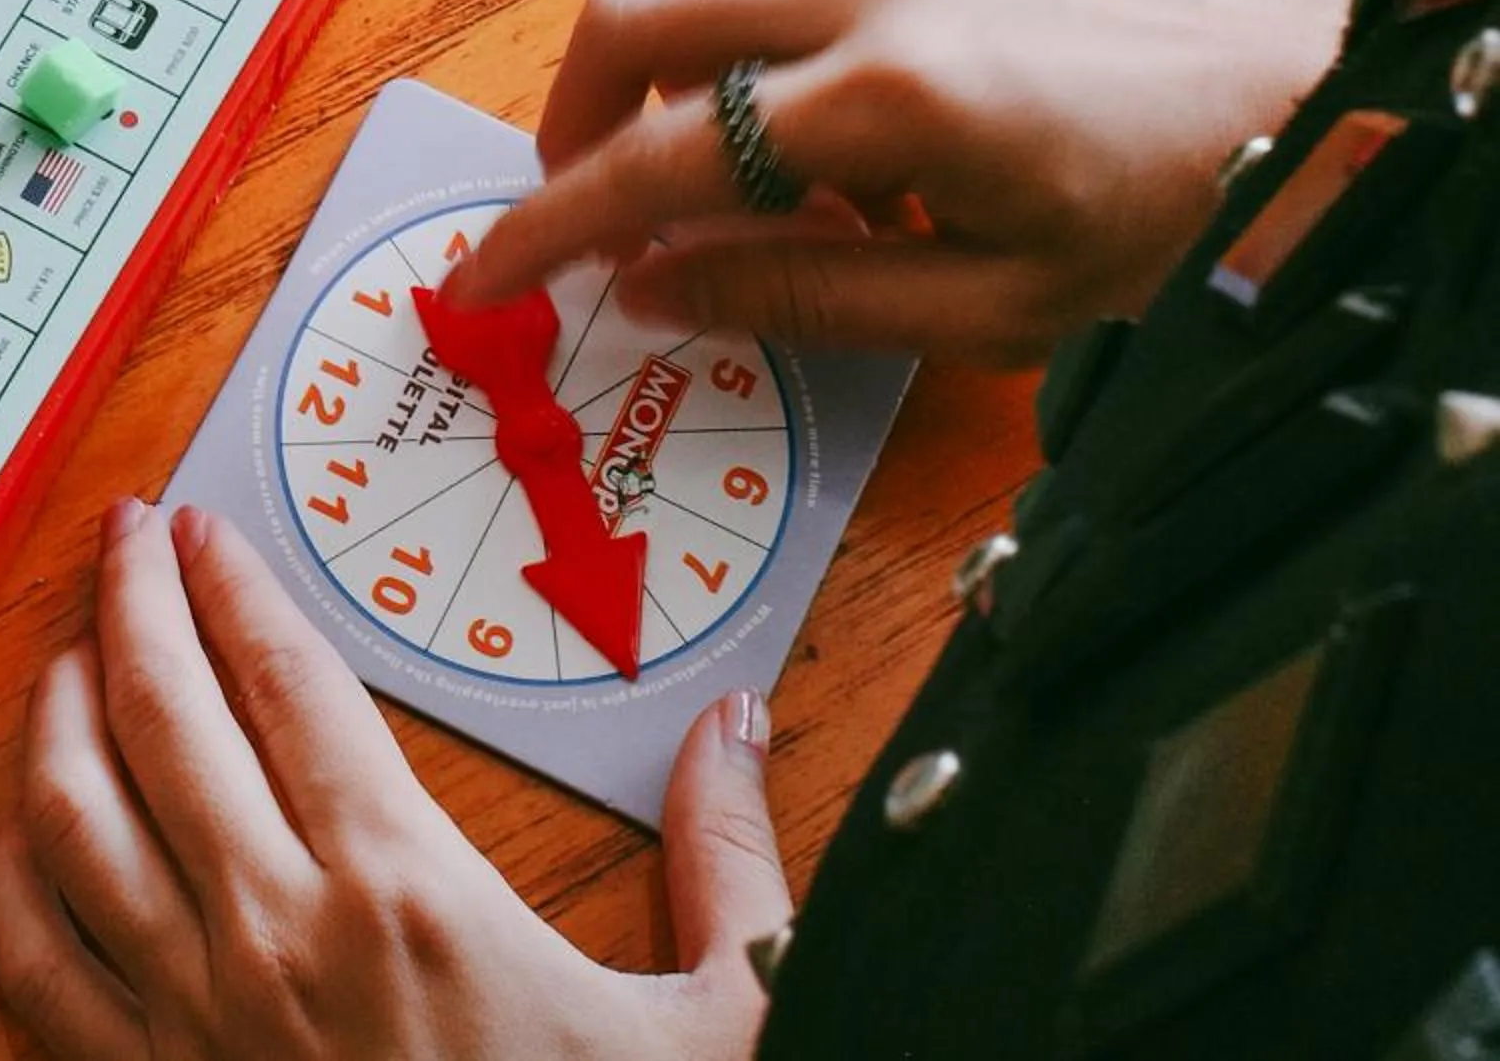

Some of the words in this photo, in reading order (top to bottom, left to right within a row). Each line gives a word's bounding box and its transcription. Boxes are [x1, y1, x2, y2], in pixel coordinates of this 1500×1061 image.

[6, 41, 40, 89] CHANCE
[352, 290, 393, 317] 1
[297, 358, 361, 427] 12
[375, 344, 444, 456] ULETTE
[711, 356, 757, 400] 5
[418, 372, 472, 454] GITAL
[593, 362, 681, 518] MONOP
[307, 458, 369, 530] 11
[722, 468, 769, 507] 6
[372, 546, 434, 617] 10
[681, 551, 730, 594] 7
[467, 618, 514, 660] 9
[735, 601, 773, 641] When
[628, 646, 713, 706] indicating
